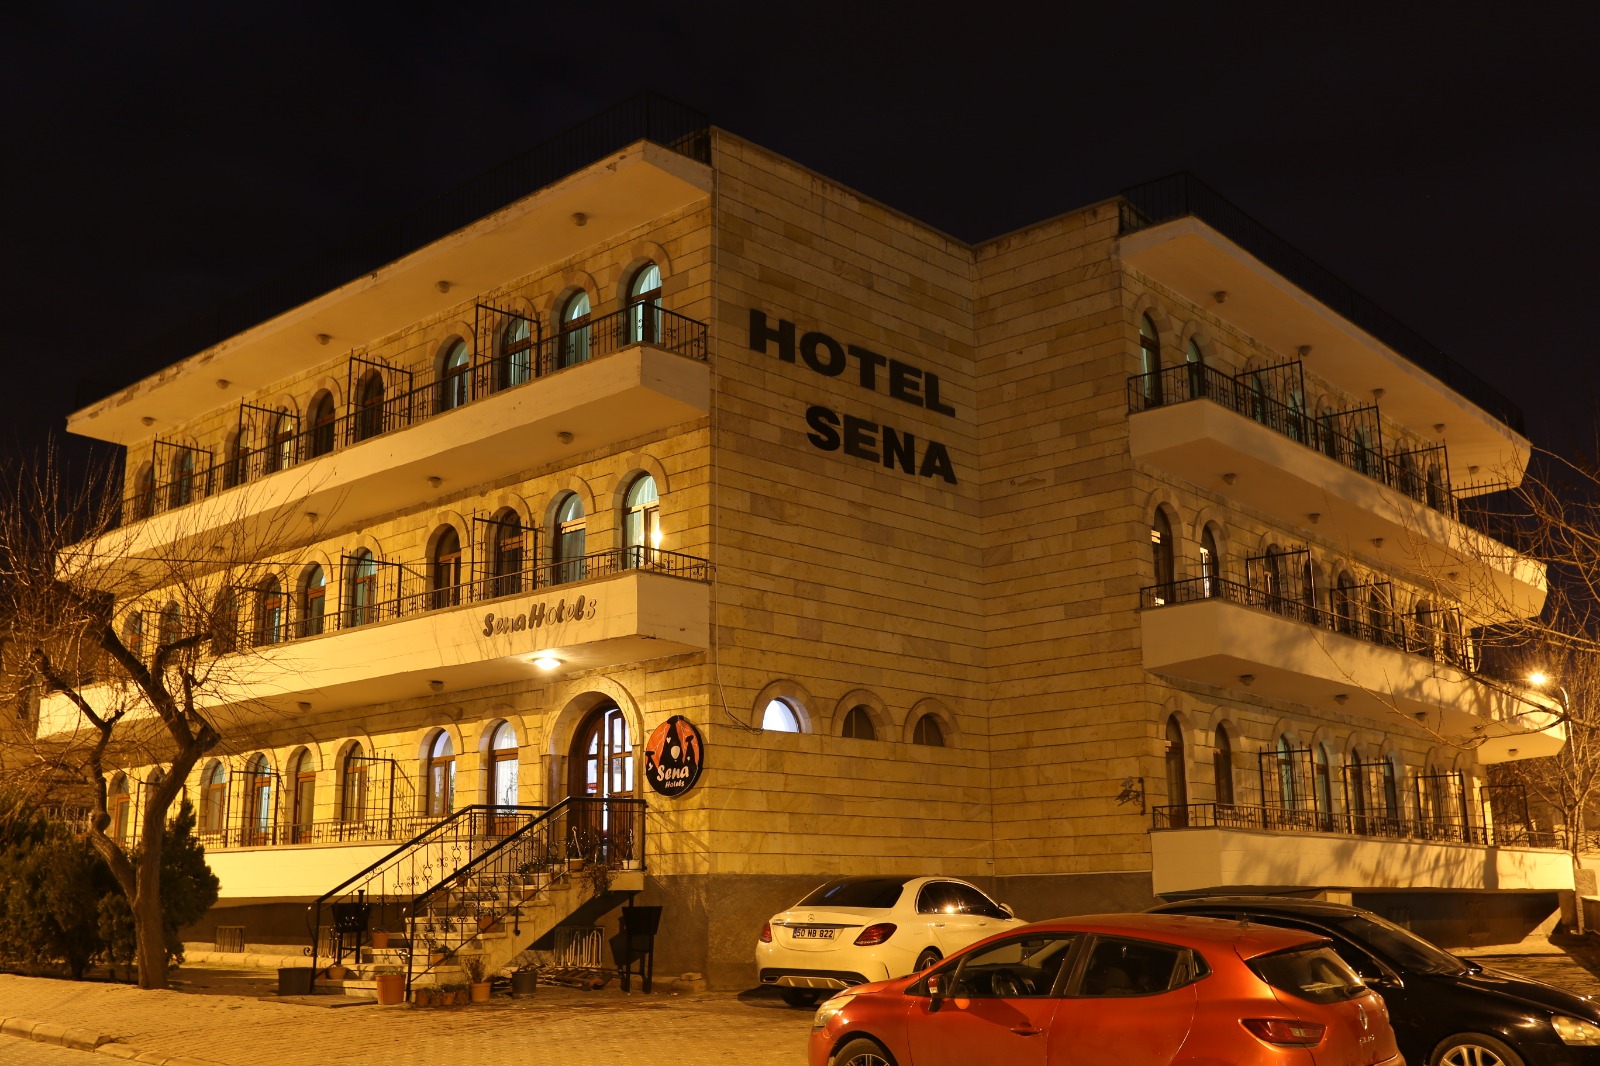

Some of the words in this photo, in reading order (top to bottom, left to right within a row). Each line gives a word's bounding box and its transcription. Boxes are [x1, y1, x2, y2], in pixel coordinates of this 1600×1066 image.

[749, 308, 956, 418] HOTEL
[805, 405, 958, 485] SENA
[656, 764, 690, 782] Sena
